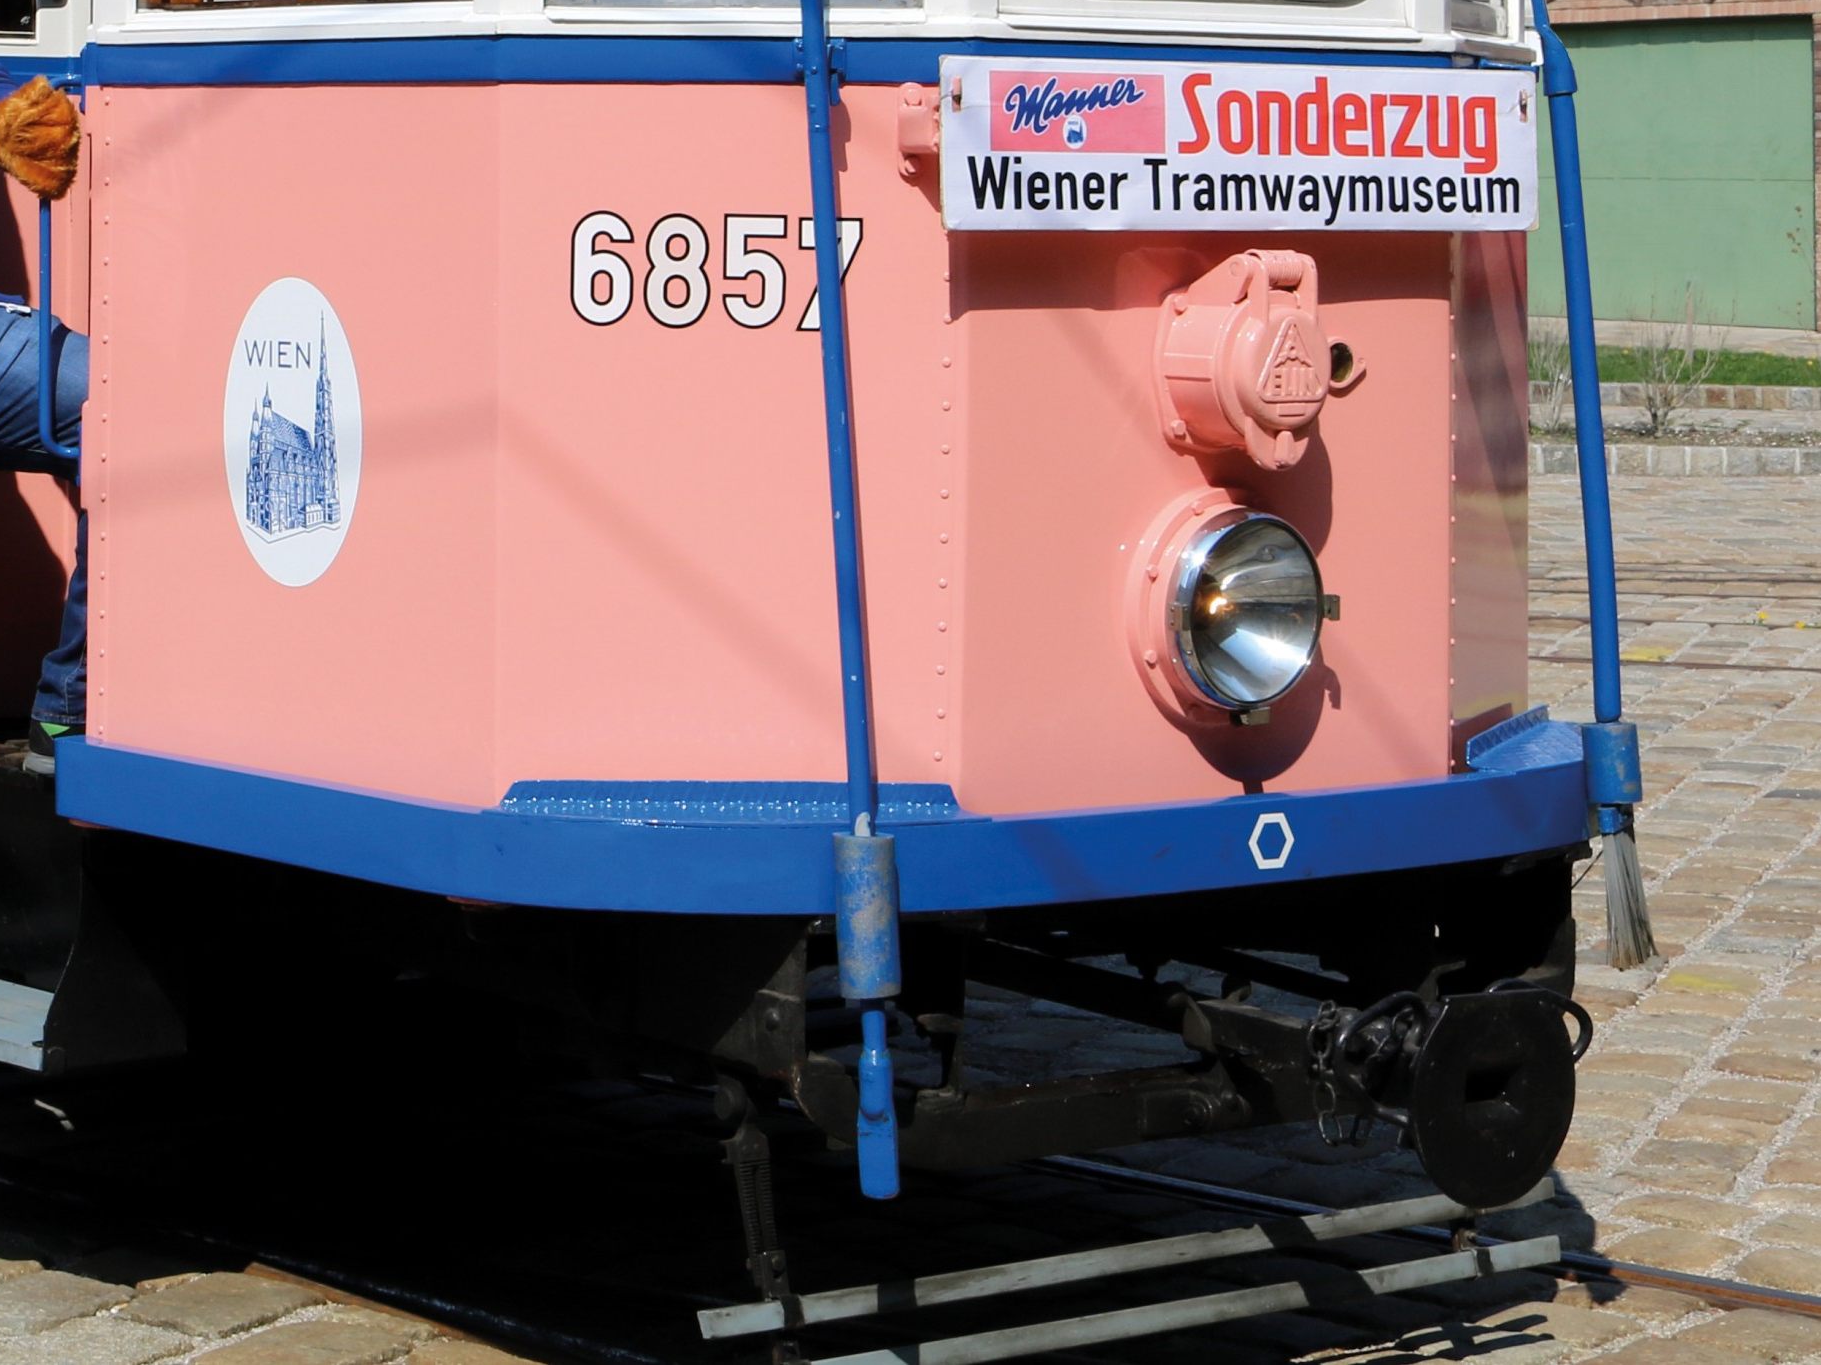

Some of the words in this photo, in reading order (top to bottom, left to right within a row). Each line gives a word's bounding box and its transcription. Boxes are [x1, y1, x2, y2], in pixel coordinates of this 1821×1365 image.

[1003, 75, 1148, 136] Manner
[1178, 72, 1499, 176] Sonderzug
[966, 154, 1128, 212] Wiener
[1142, 157, 1521, 227] Tramwaymuseum
[244, 339, 312, 370] WIEN
